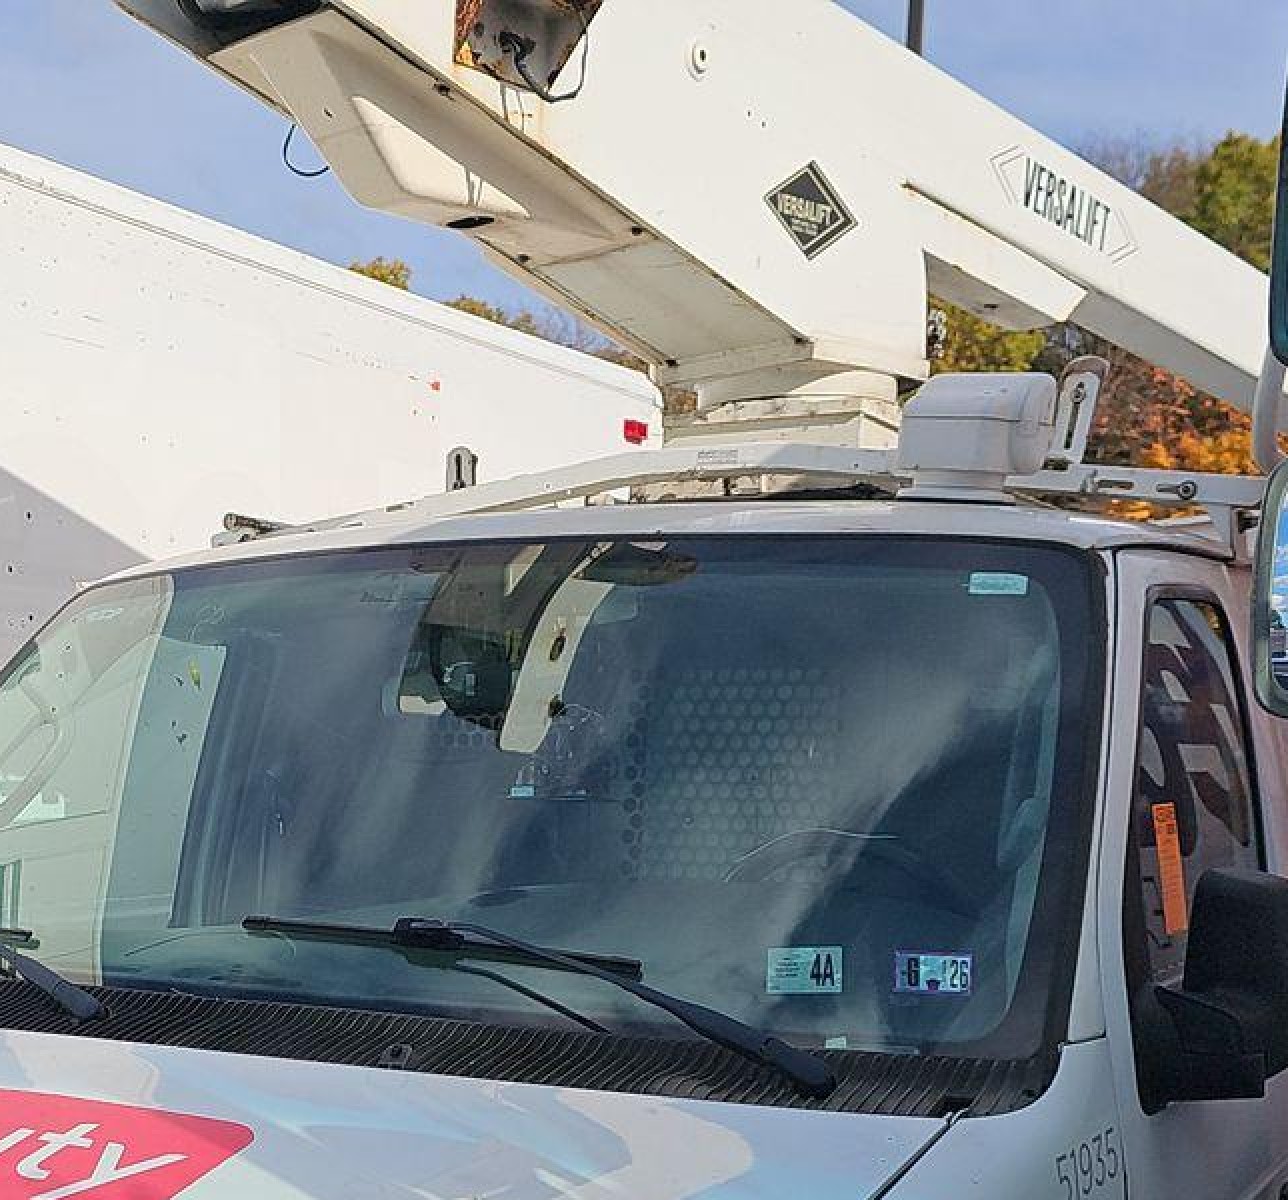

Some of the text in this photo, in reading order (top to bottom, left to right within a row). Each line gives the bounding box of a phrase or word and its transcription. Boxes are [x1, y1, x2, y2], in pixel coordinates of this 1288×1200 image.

[777, 192, 833, 227] VERSALIFT
[1024, 157, 1111, 252] VERSALIFT
[809, 953, 835, 987] 4A
